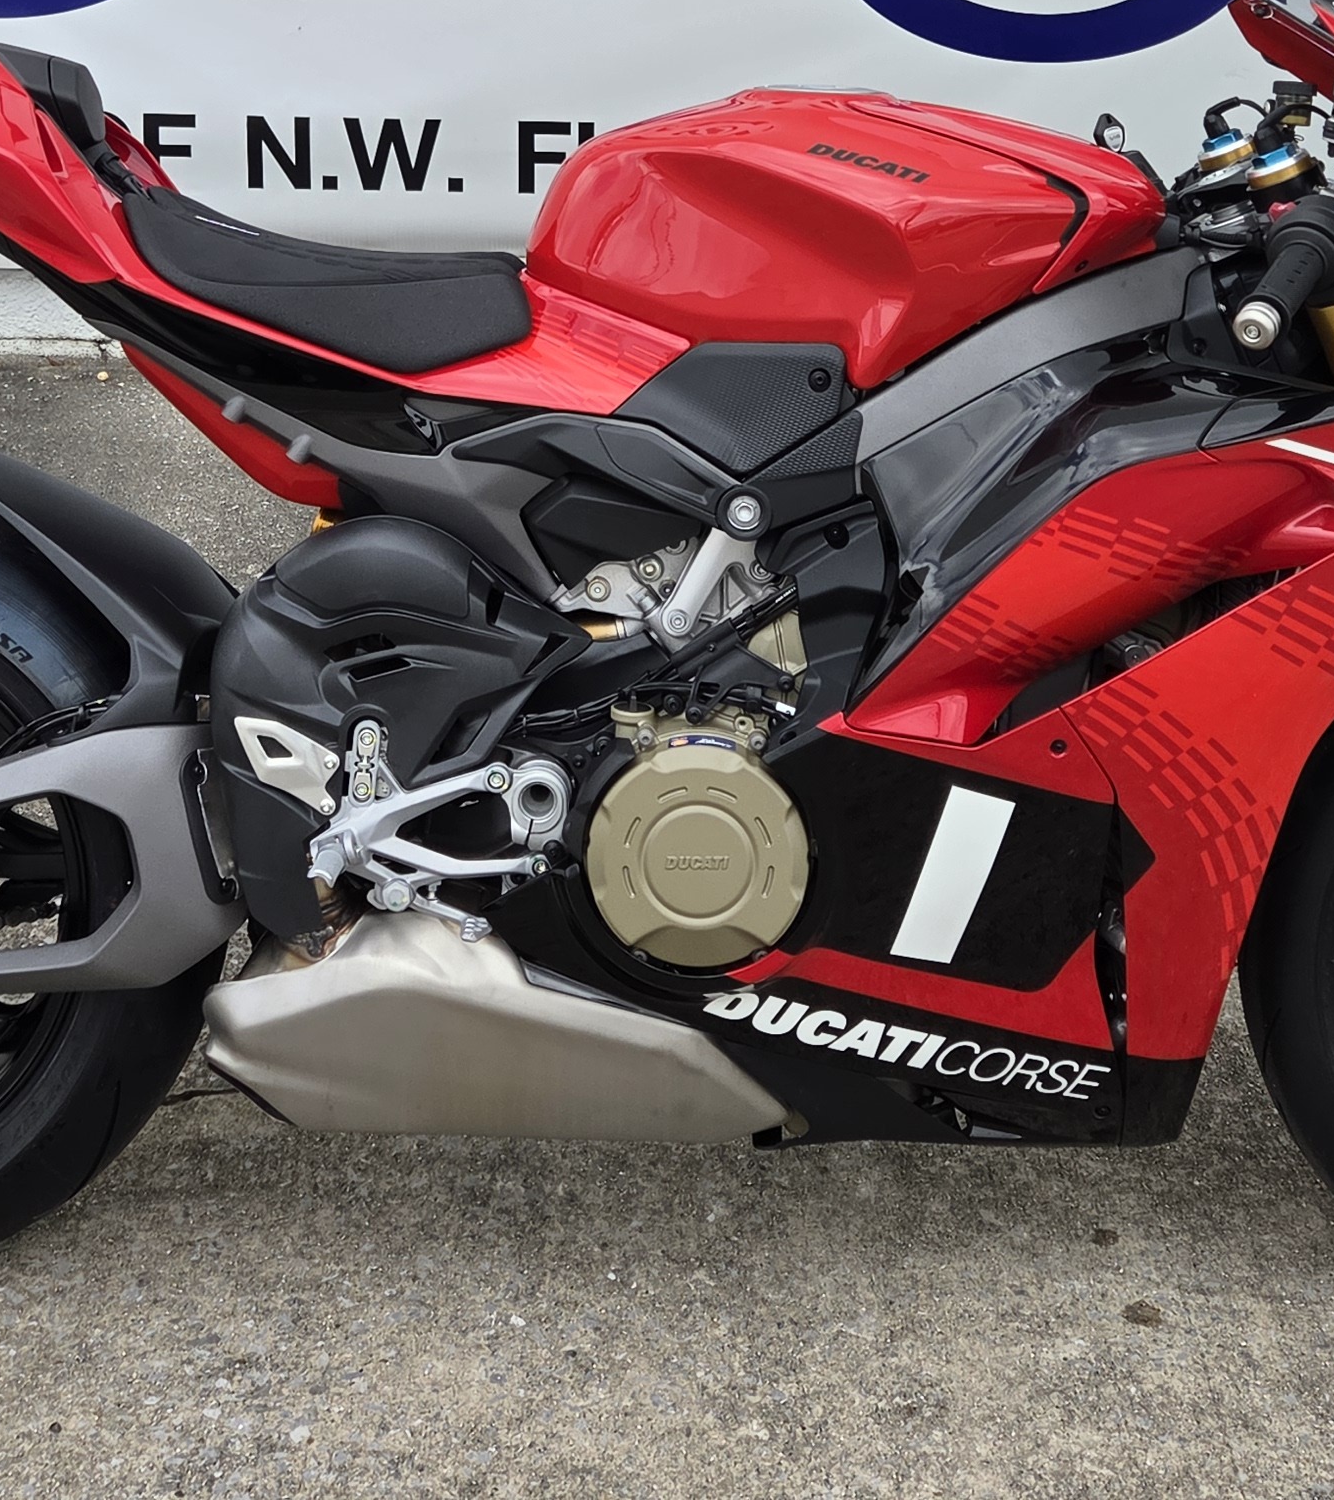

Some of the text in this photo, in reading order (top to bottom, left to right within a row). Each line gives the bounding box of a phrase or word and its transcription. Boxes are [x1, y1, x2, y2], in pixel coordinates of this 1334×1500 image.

[247, 115, 464, 192] N.W.
[807, 143, 931, 184] DUCATI
[664, 855, 730, 871] DUCATI
